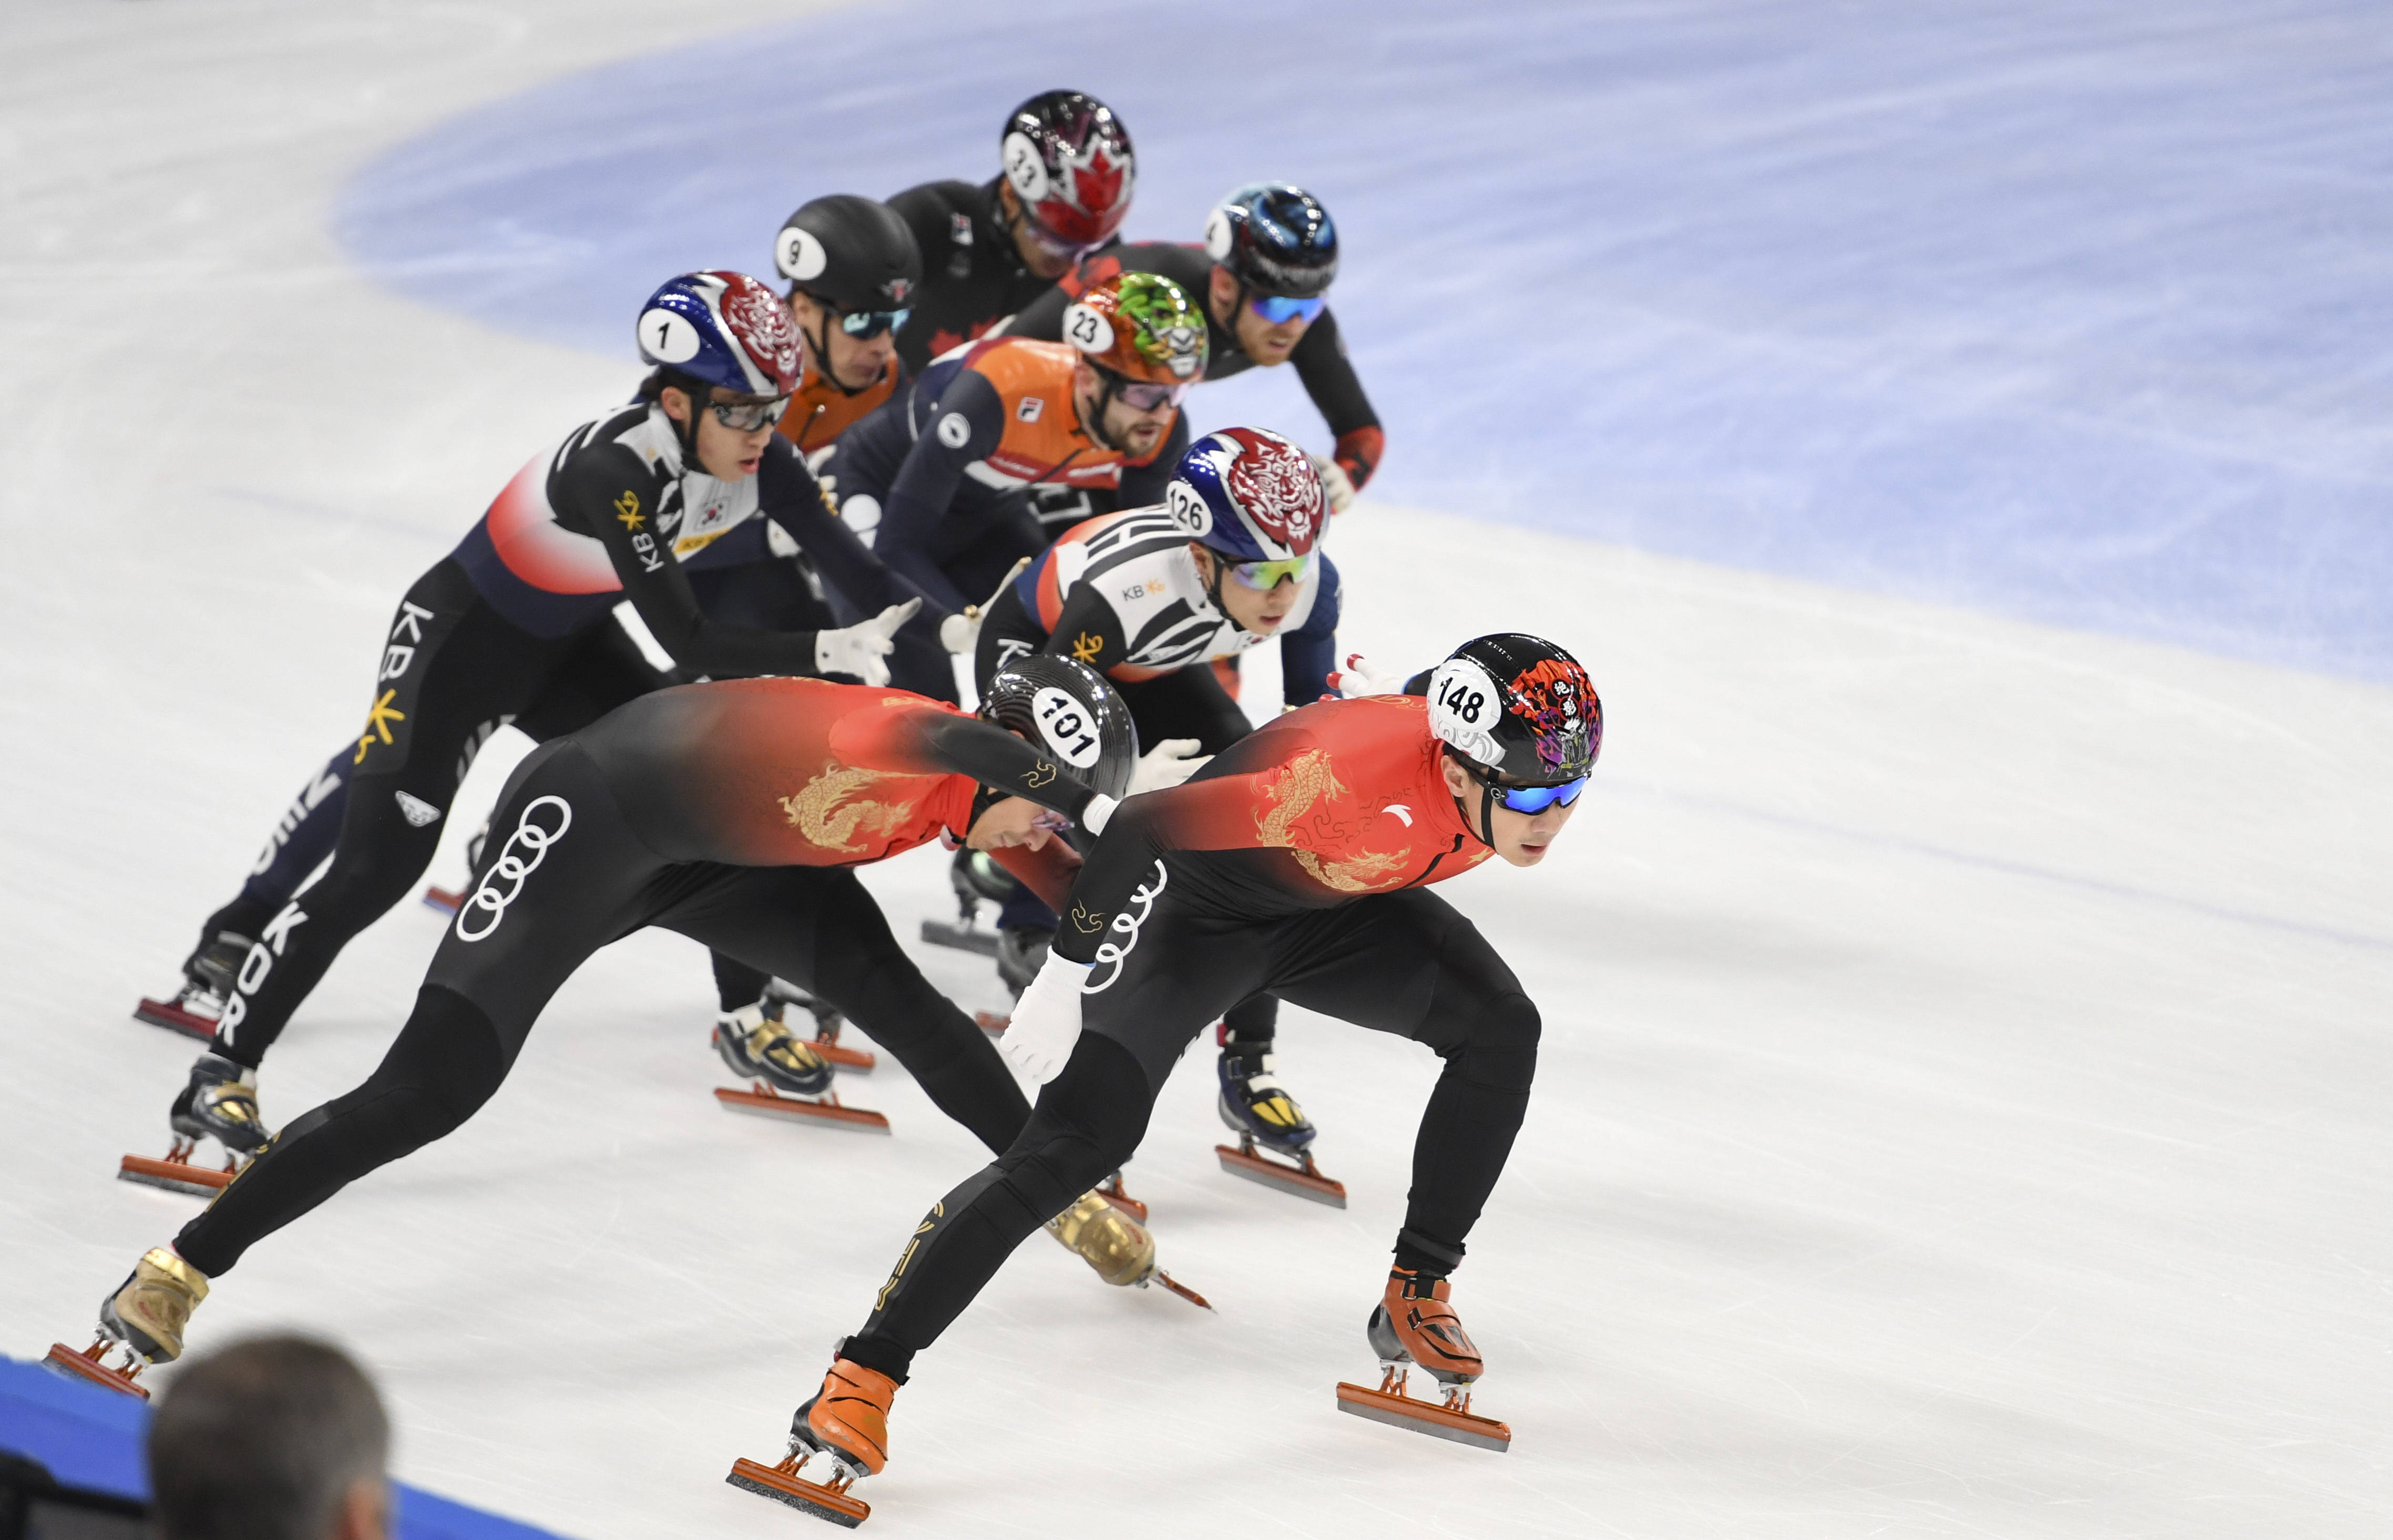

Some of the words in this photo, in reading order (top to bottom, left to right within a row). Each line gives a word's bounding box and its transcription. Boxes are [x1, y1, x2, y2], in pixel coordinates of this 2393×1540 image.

[790, 240, 801, 265] 9
[657, 322, 671, 350] 1
[1072, 311, 1098, 343] 23
[1170, 488, 1203, 531] 126
[632, 532, 665, 572] KB
[1122, 584, 1144, 601] KB
[378, 600, 434, 682] KB
[1437, 676, 1485, 724] 148
[1042, 696, 1096, 757] 101
[214, 901, 309, 1046] KOR
